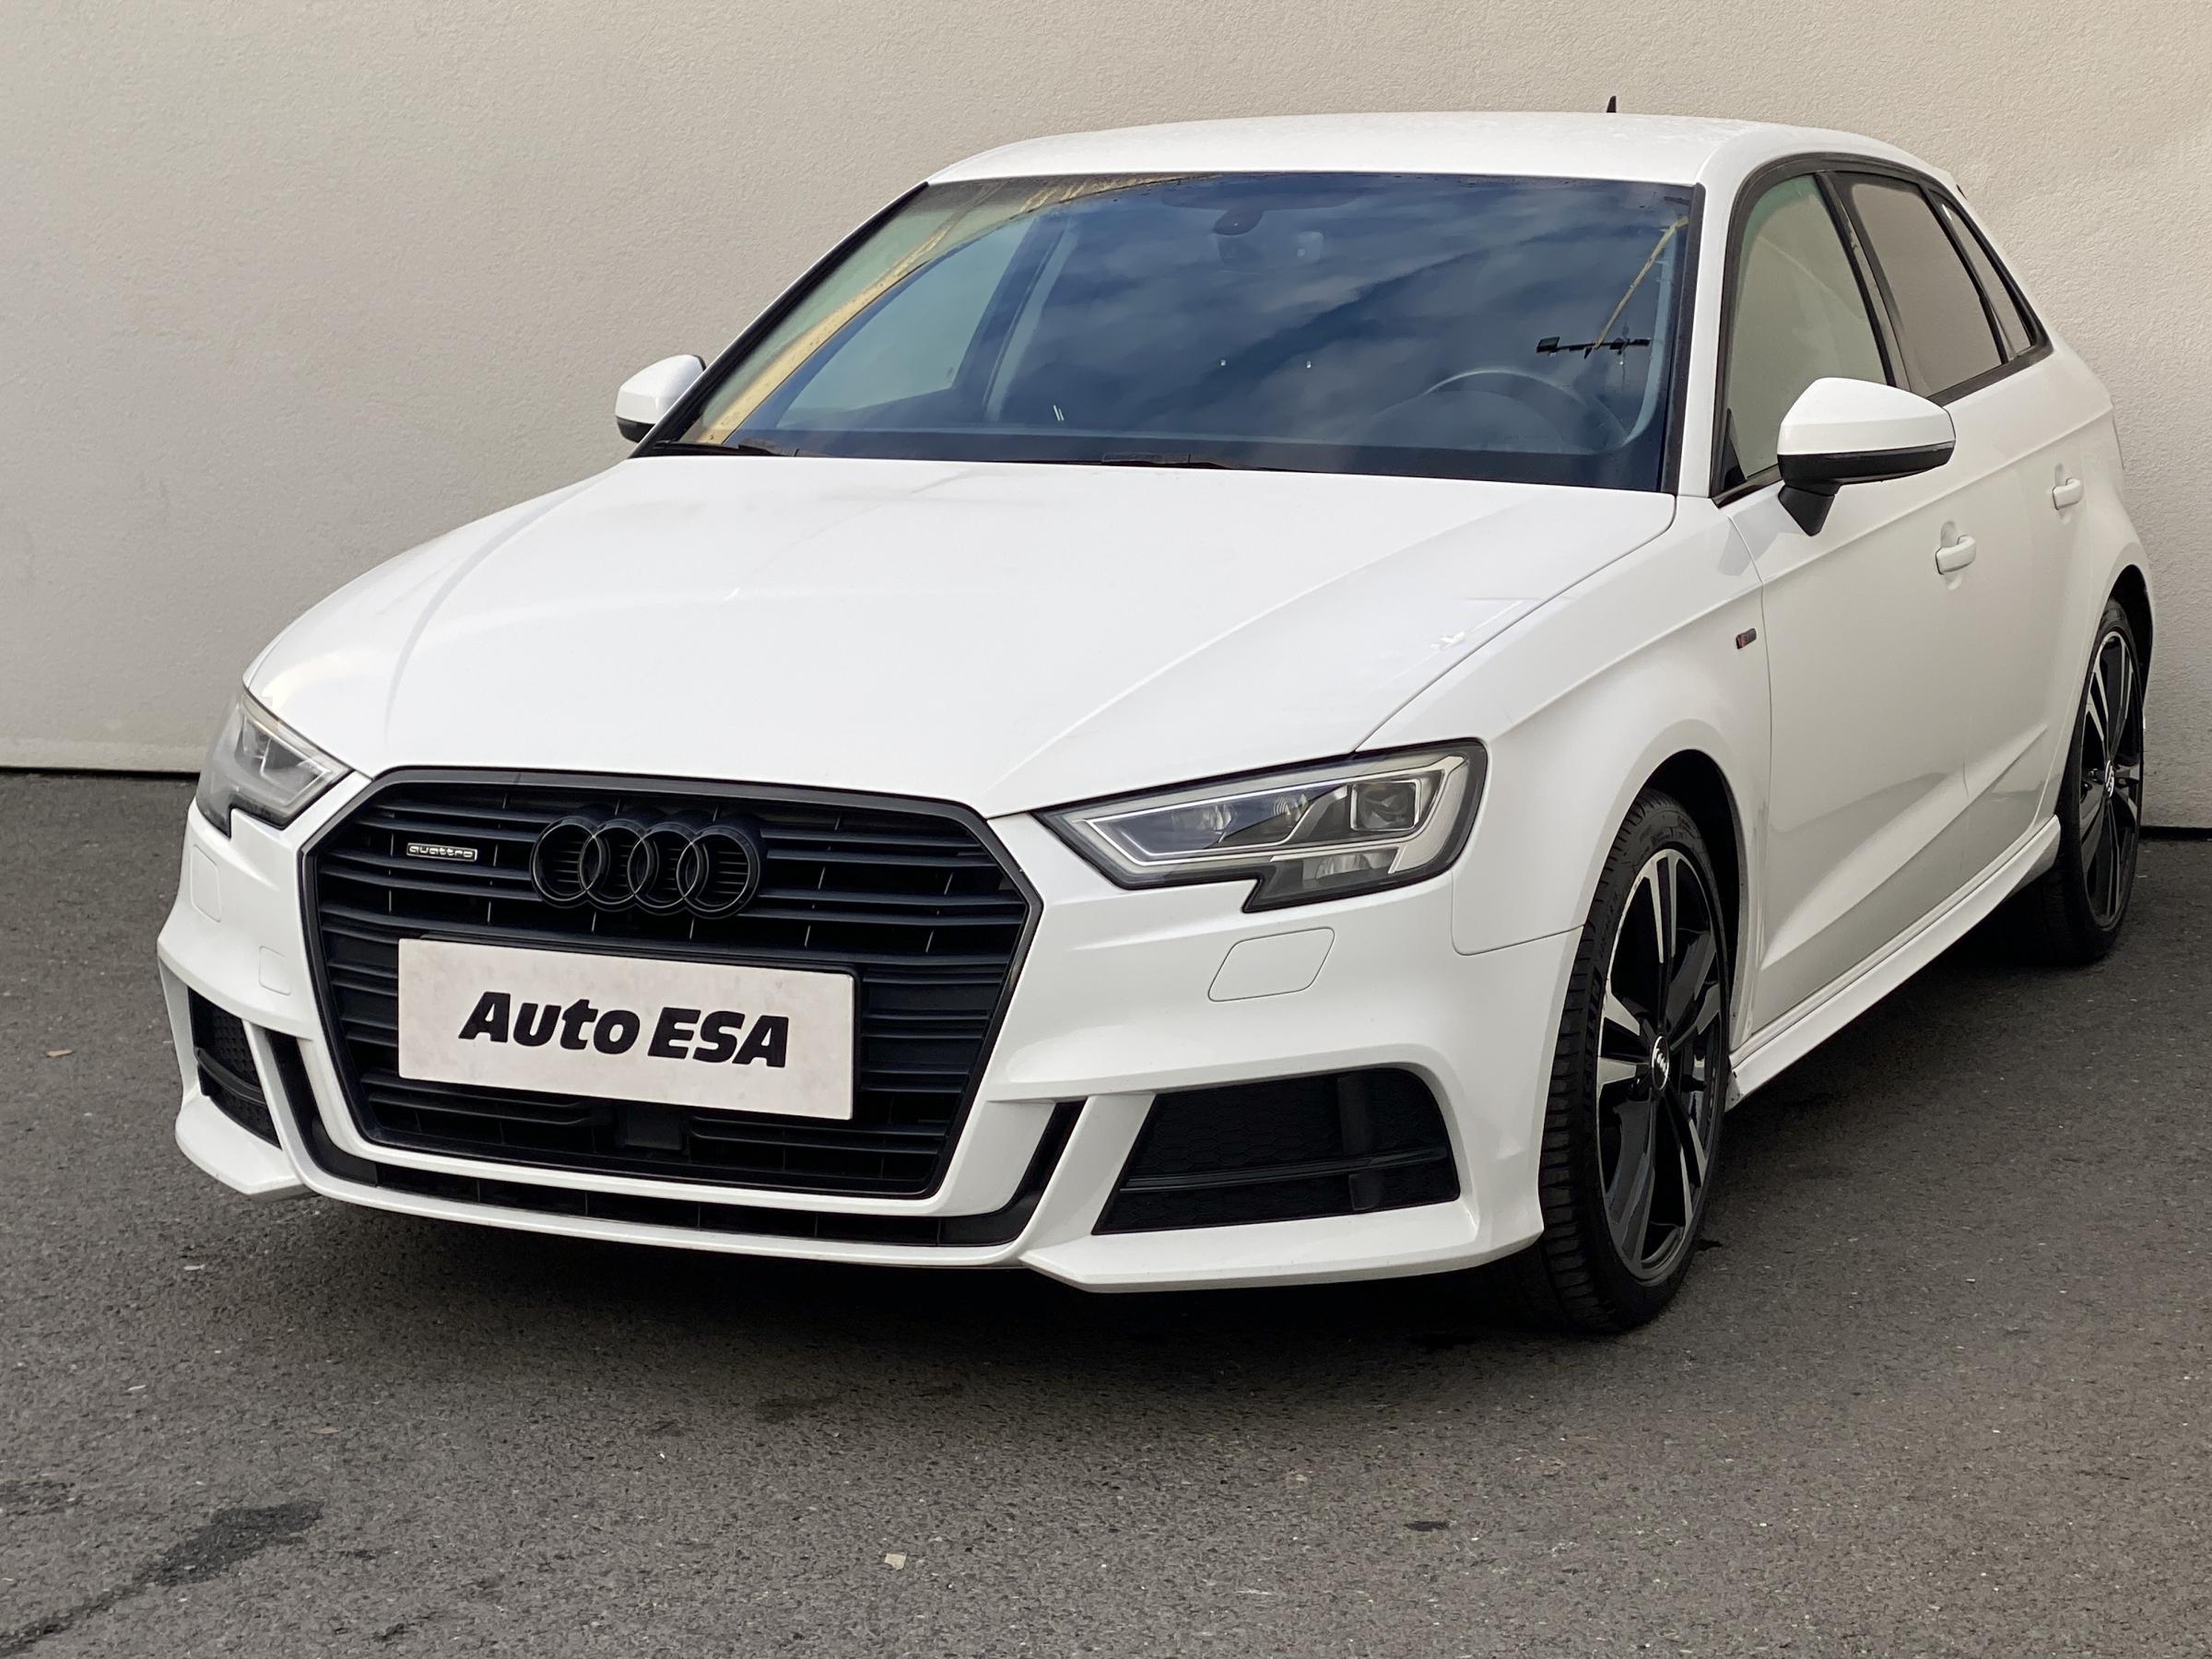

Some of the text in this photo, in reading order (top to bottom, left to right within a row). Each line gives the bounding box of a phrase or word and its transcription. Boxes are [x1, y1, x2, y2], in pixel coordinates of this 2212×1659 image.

[408, 845, 474, 858] quattro
[459, 991, 790, 1068] Auto ESA
